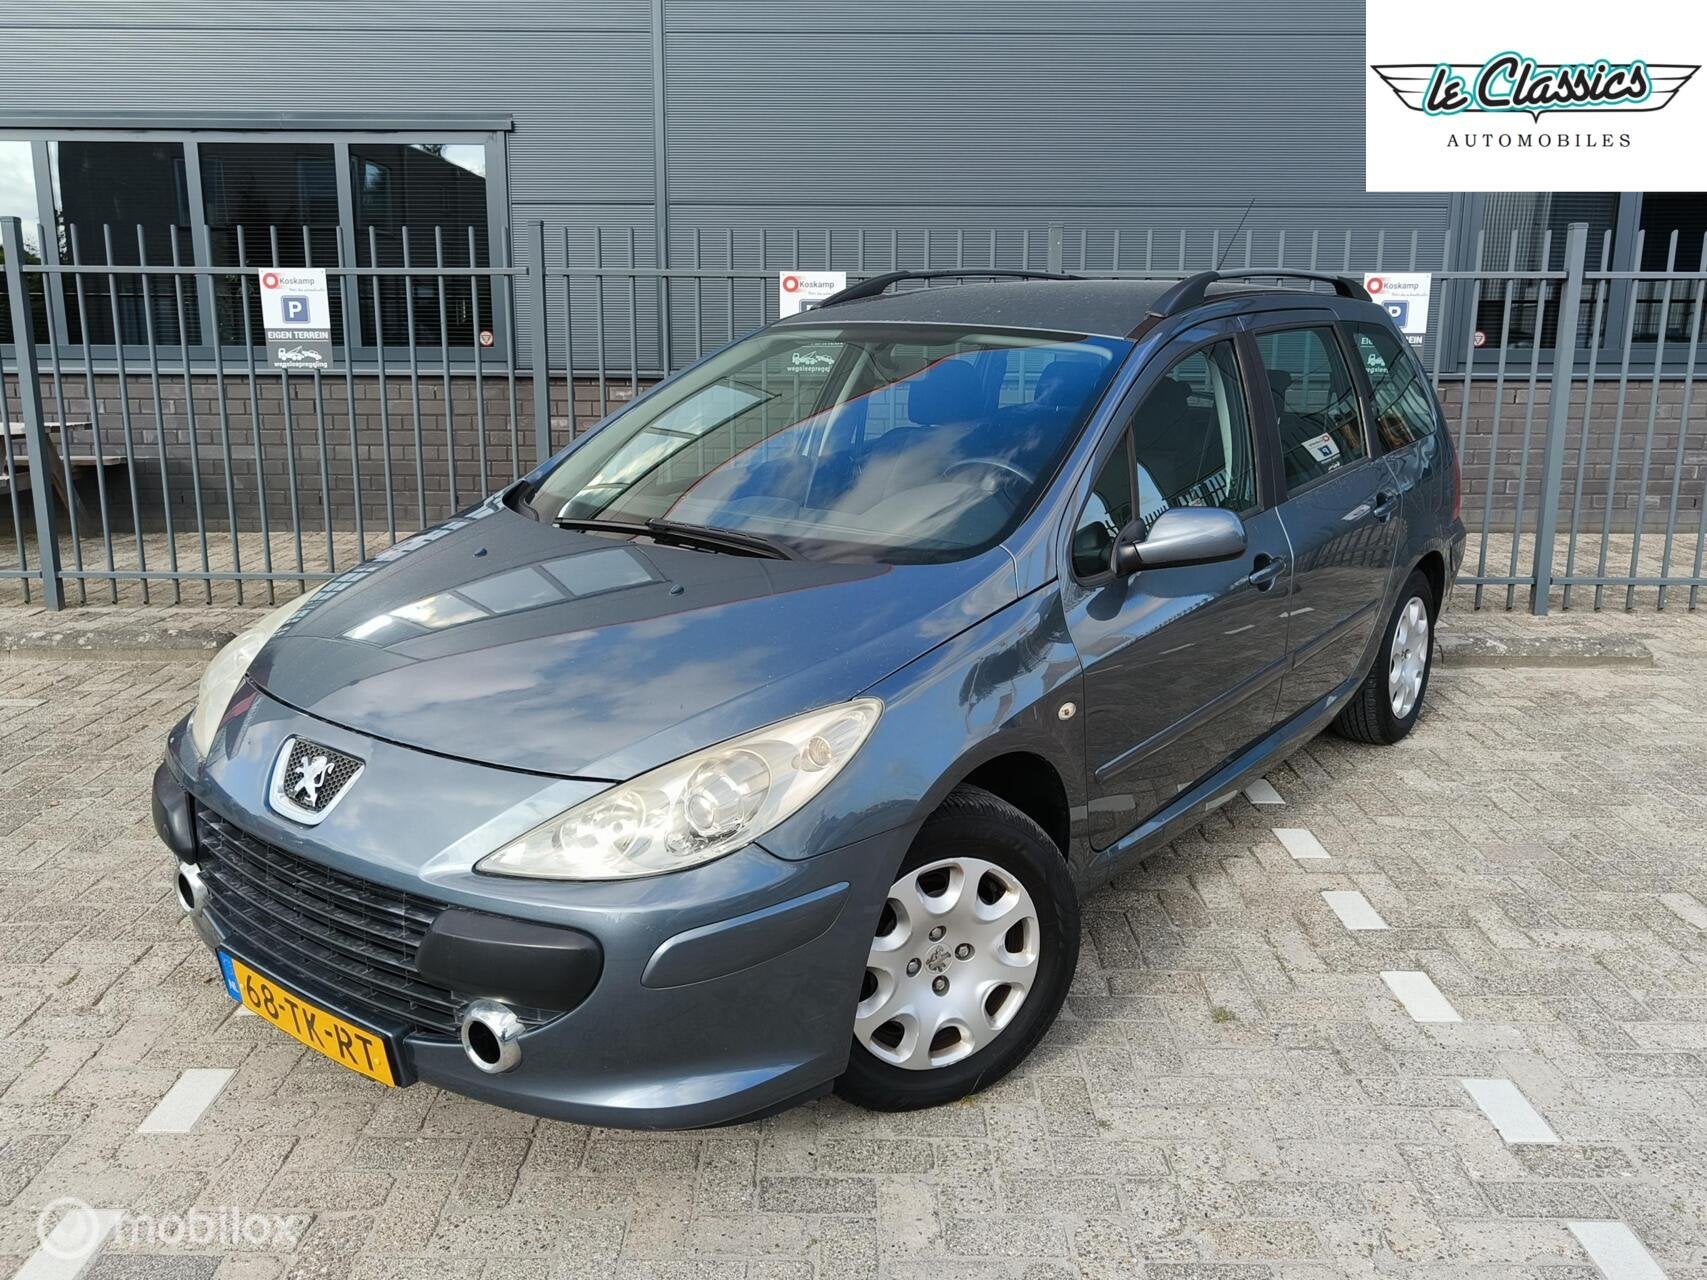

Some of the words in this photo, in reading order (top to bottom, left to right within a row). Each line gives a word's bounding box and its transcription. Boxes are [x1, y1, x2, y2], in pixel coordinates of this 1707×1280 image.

[279, 277, 315, 286] Koskamp
[799, 281, 835, 289] Koskamp
[1383, 282, 1419, 290] Koskamp
[288, 301, 302, 319] P
[267, 331, 292, 339] EIGEN
[294, 331, 329, 339] TERREIN
[246, 974, 375, 1071] 68-TK-RT
